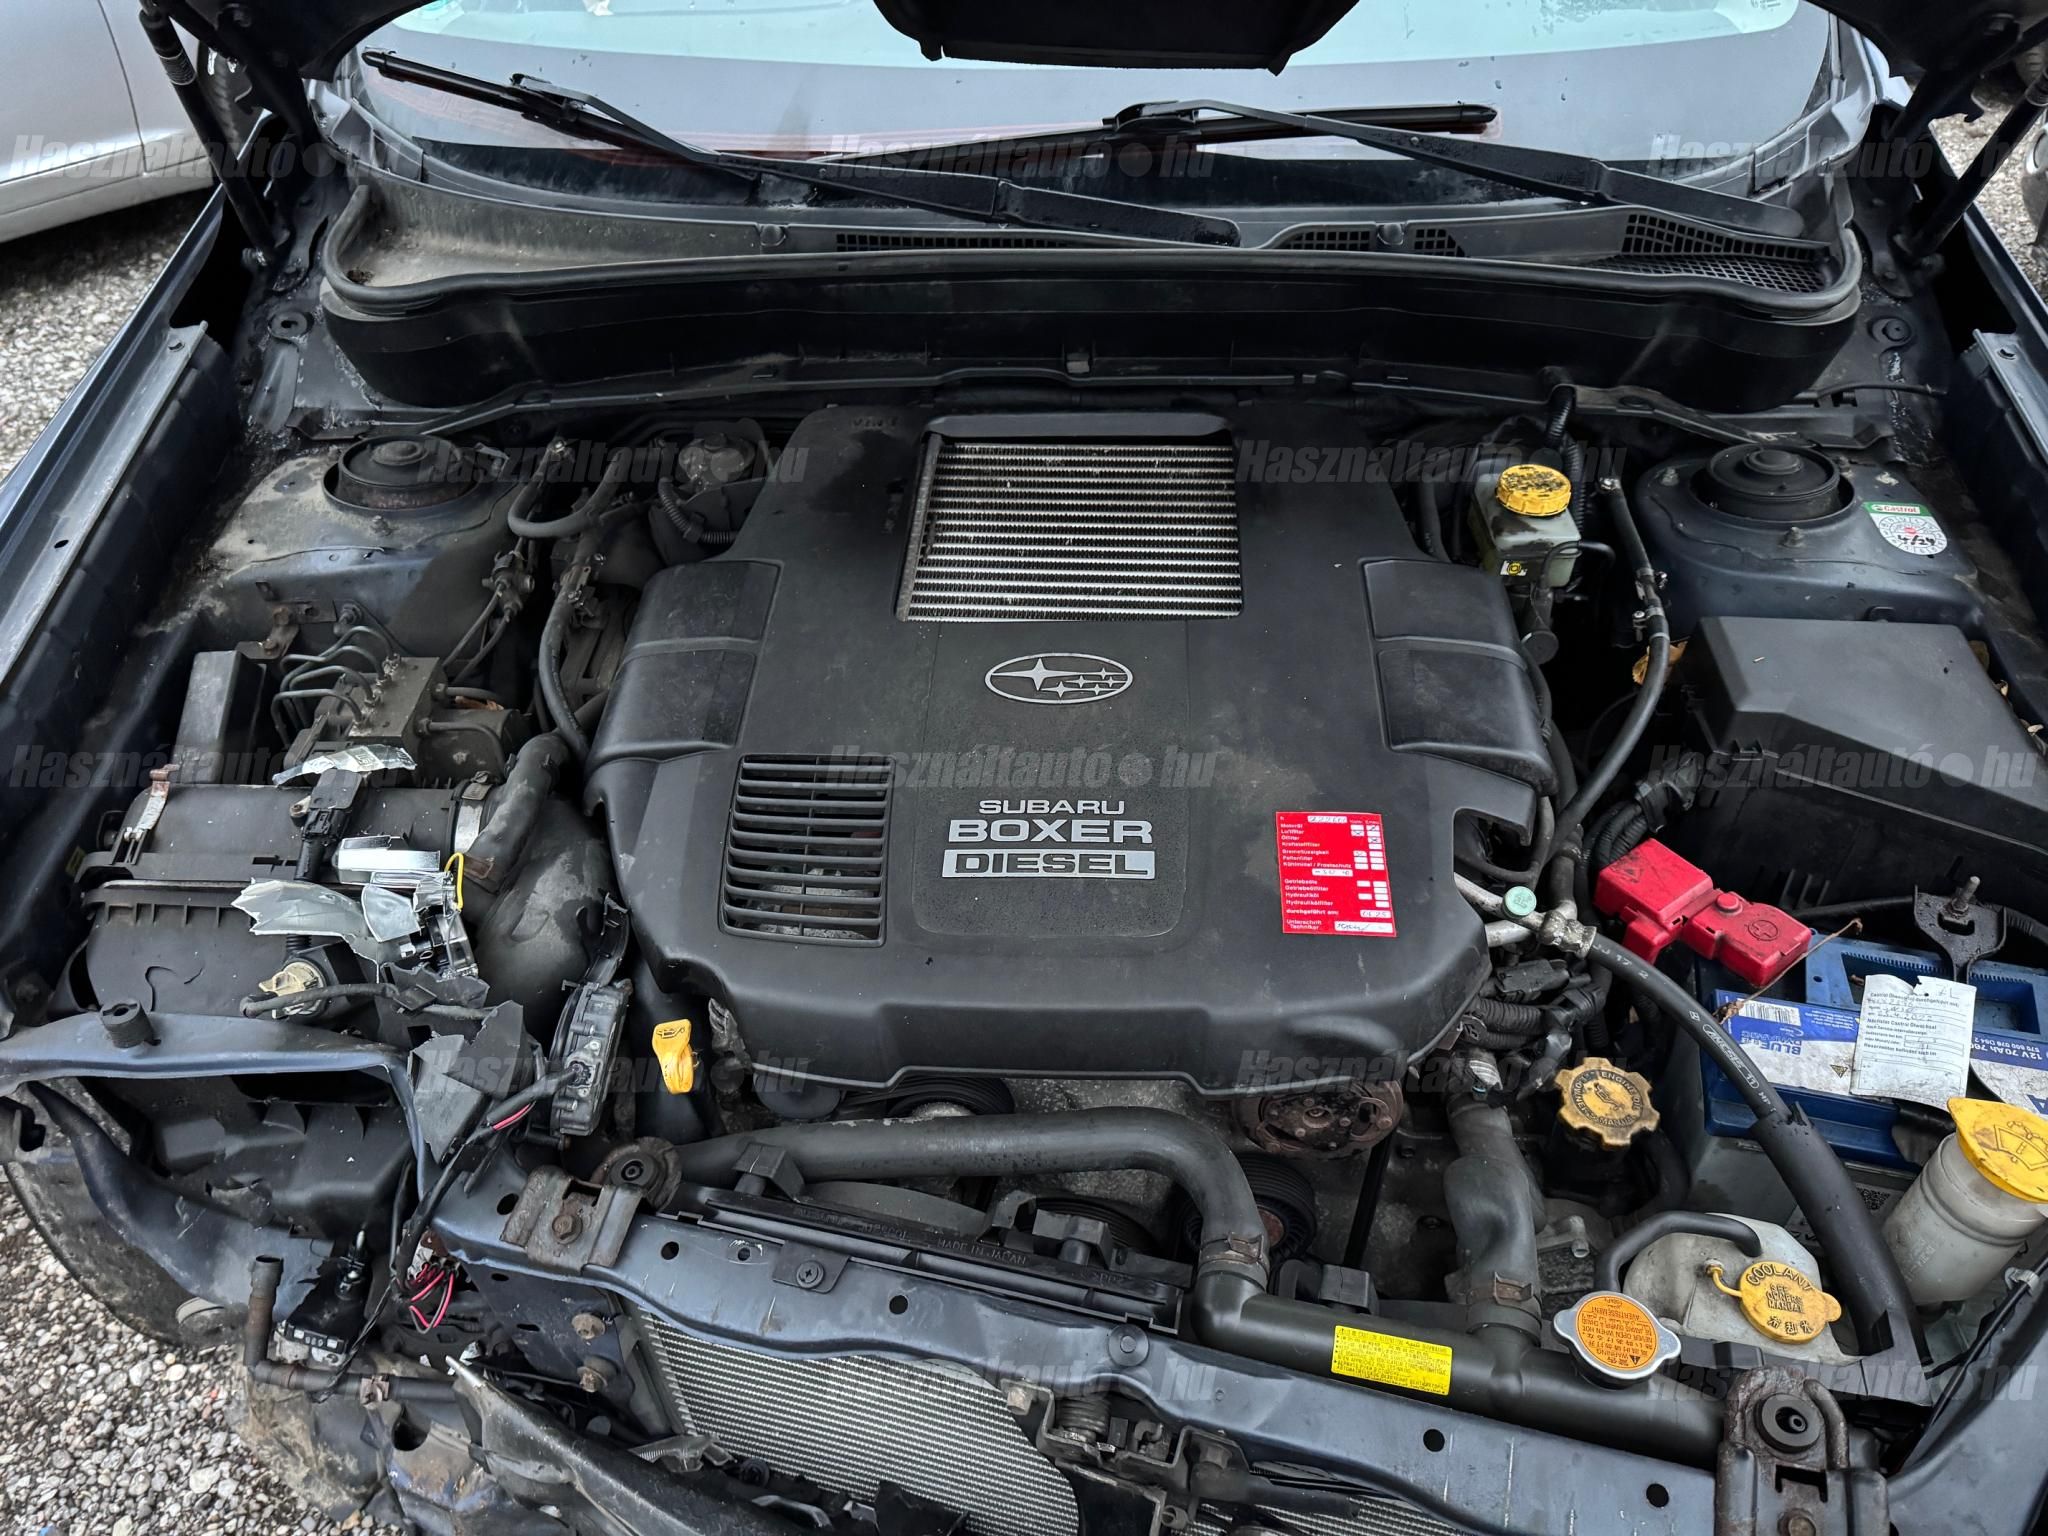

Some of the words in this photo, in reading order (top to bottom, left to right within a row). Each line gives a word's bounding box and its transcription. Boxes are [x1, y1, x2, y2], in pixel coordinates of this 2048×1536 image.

[978, 800, 1125, 815] SUBARU
[948, 819, 1153, 844] BOXER
[955, 852, 1148, 876] DIESEL
[1760, 1040, 1801, 1056] BLUE
[1990, 1046, 2020, 1057] 70Ah
[2022, 1050, 2043, 1060] 12V
[1601, 1071, 1637, 1094] ENGINE
[1746, 1263, 1814, 1291] COOLANT
[1591, 1306, 1640, 1320] AVERTISSEMENT
[1768, 1300, 1804, 1313] MANUAL
[1596, 1348, 1628, 1360] WARNING
